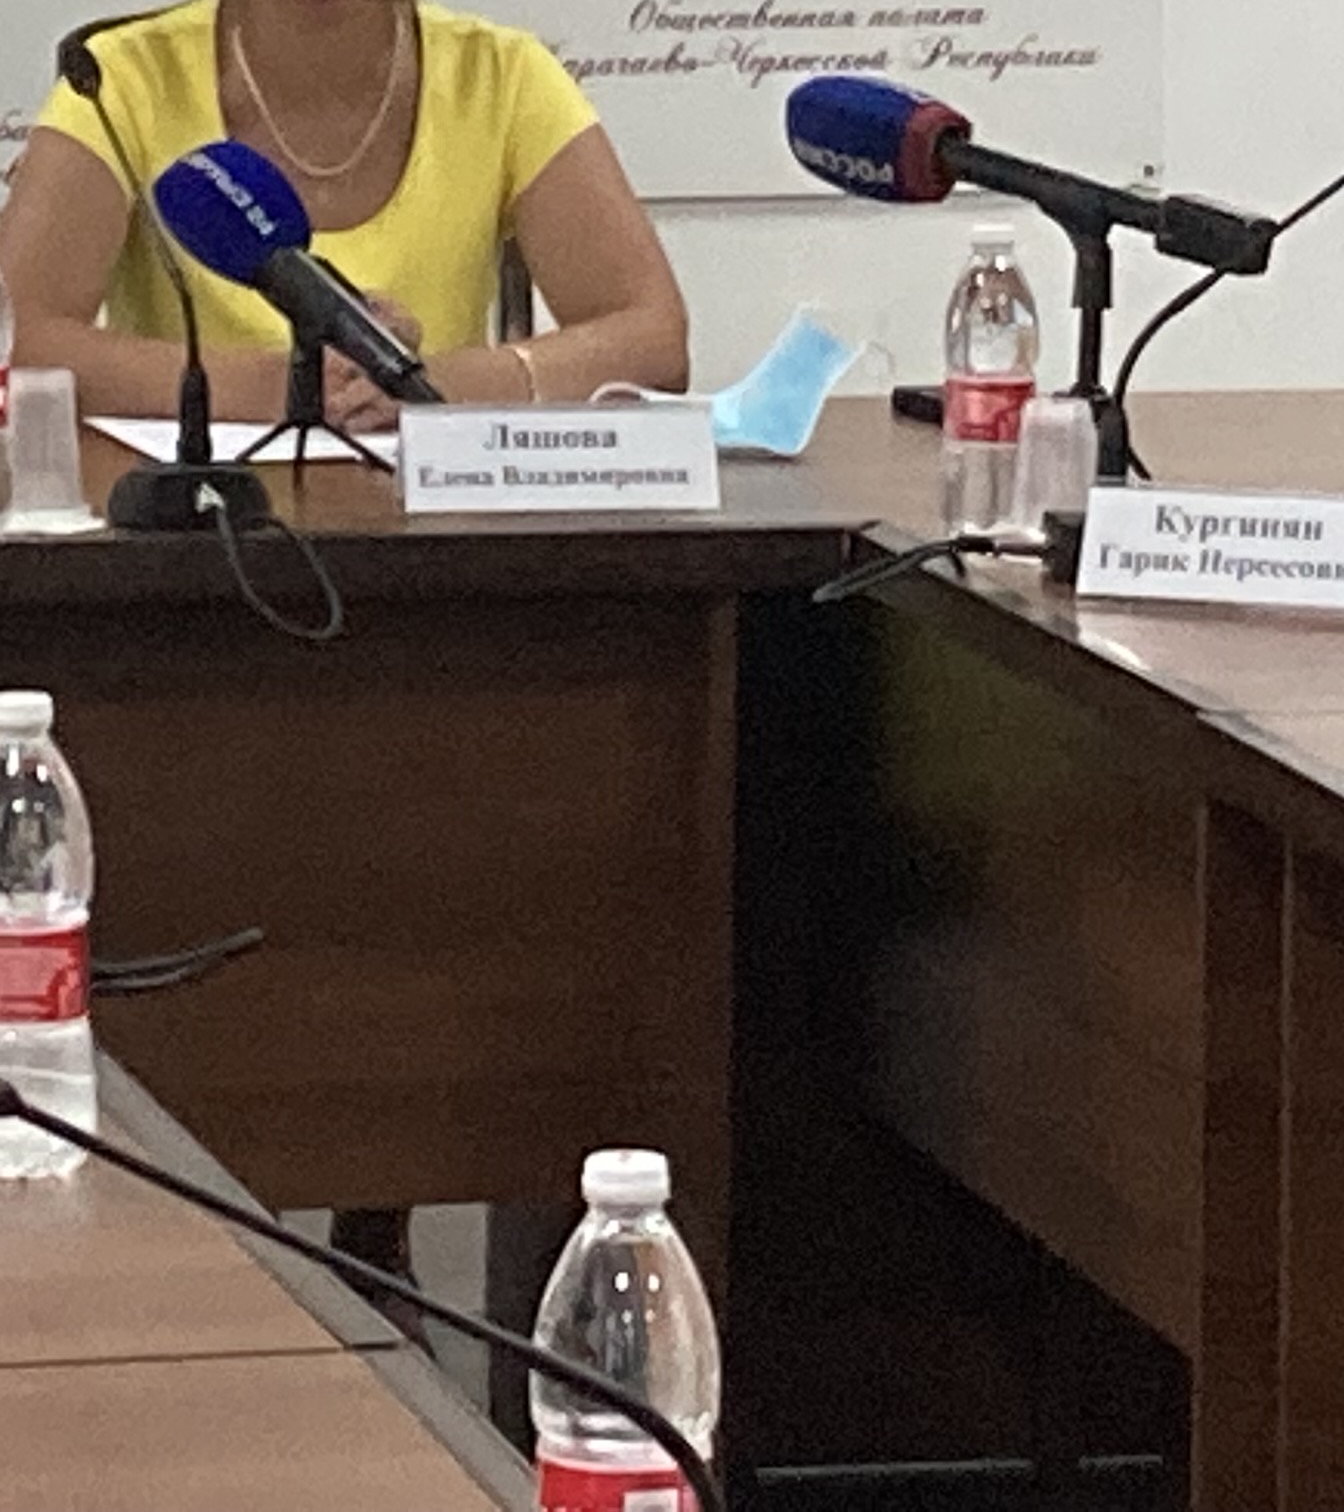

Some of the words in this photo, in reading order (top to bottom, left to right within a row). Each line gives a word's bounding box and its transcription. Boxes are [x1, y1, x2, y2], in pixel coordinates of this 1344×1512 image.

[867, 8, 988, 27] палата
[553, 38, 889, 89] арачаево-Черкесской
[918, 35, 1097, 82] Республики
[483, 424, 617, 450] Ляшова
[418, 467, 494, 488] Елена
[1155, 505, 1323, 543] Кургинян
[1100, 543, 1190, 577] Гарик
